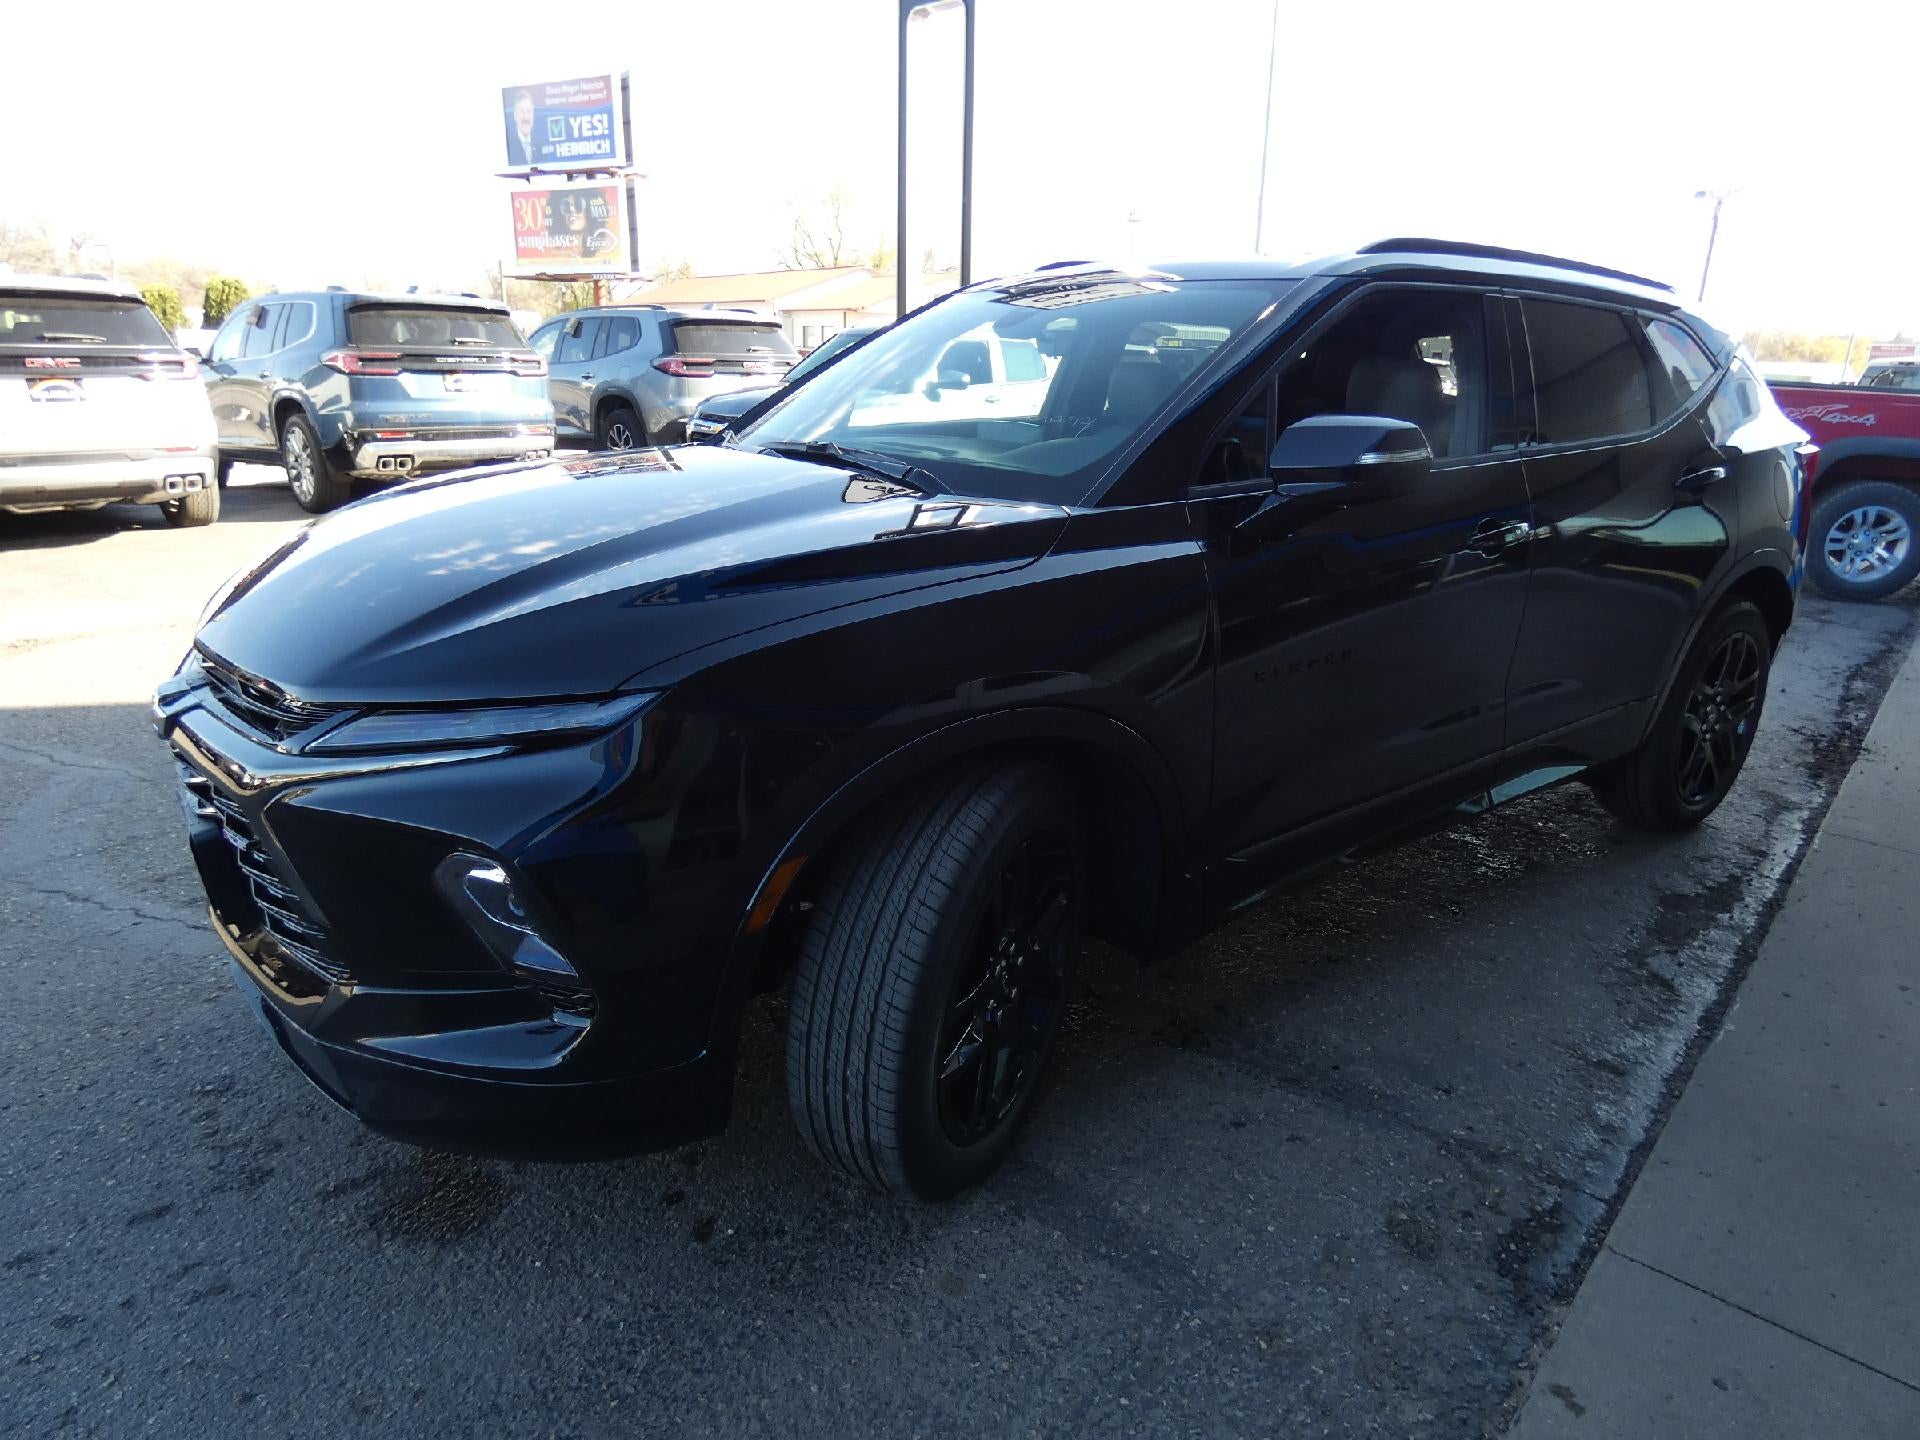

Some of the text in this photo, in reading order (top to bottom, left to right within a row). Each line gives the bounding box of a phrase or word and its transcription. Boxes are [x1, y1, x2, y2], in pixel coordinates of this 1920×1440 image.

[570, 114, 609, 138] YES!
[556, 139, 611, 157] HEINRICH
[518, 231, 580, 251] sunglasses
[25, 357, 82, 368] GMC
